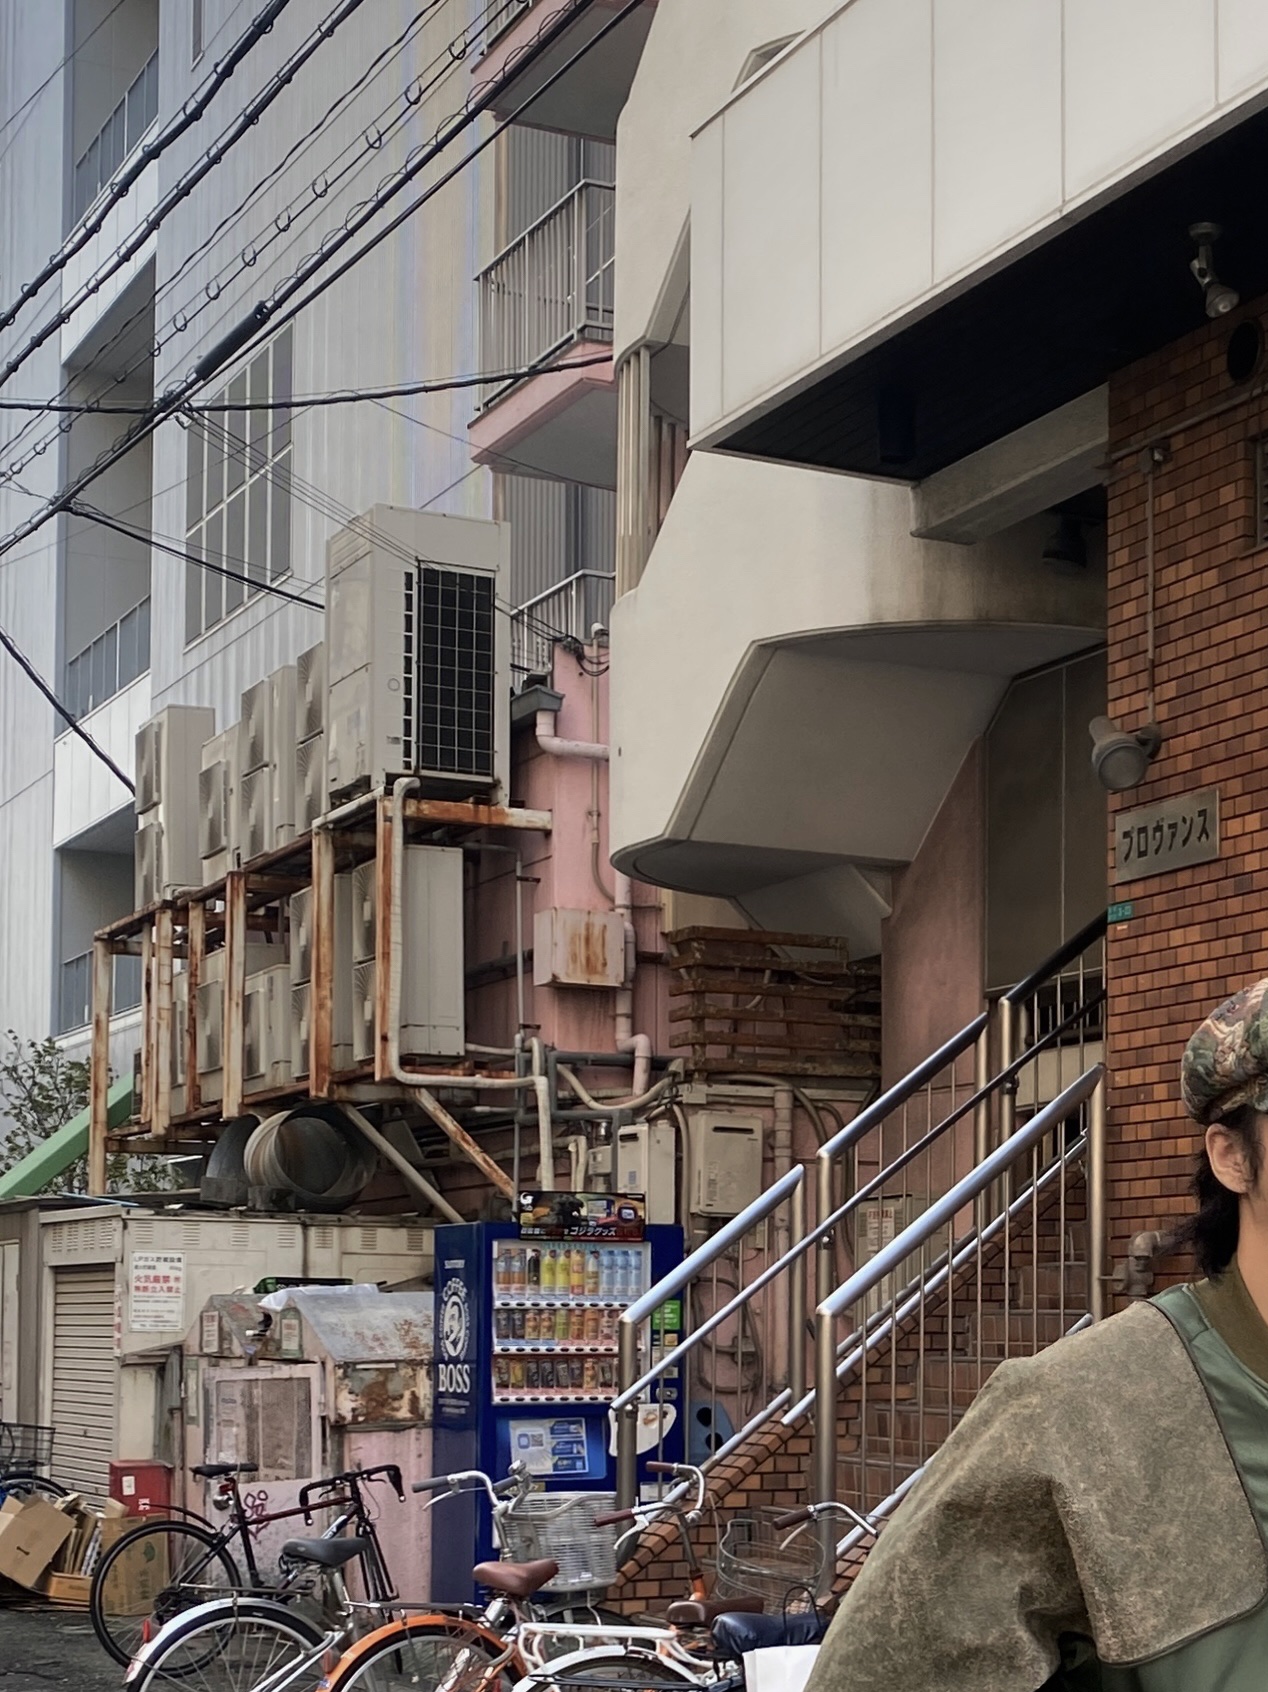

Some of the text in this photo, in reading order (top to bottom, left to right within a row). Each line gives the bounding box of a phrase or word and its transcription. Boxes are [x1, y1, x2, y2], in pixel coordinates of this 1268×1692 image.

[1122, 808, 1210, 863] プロヴァンス
[438, 1363, 470, 1393] BOSS
